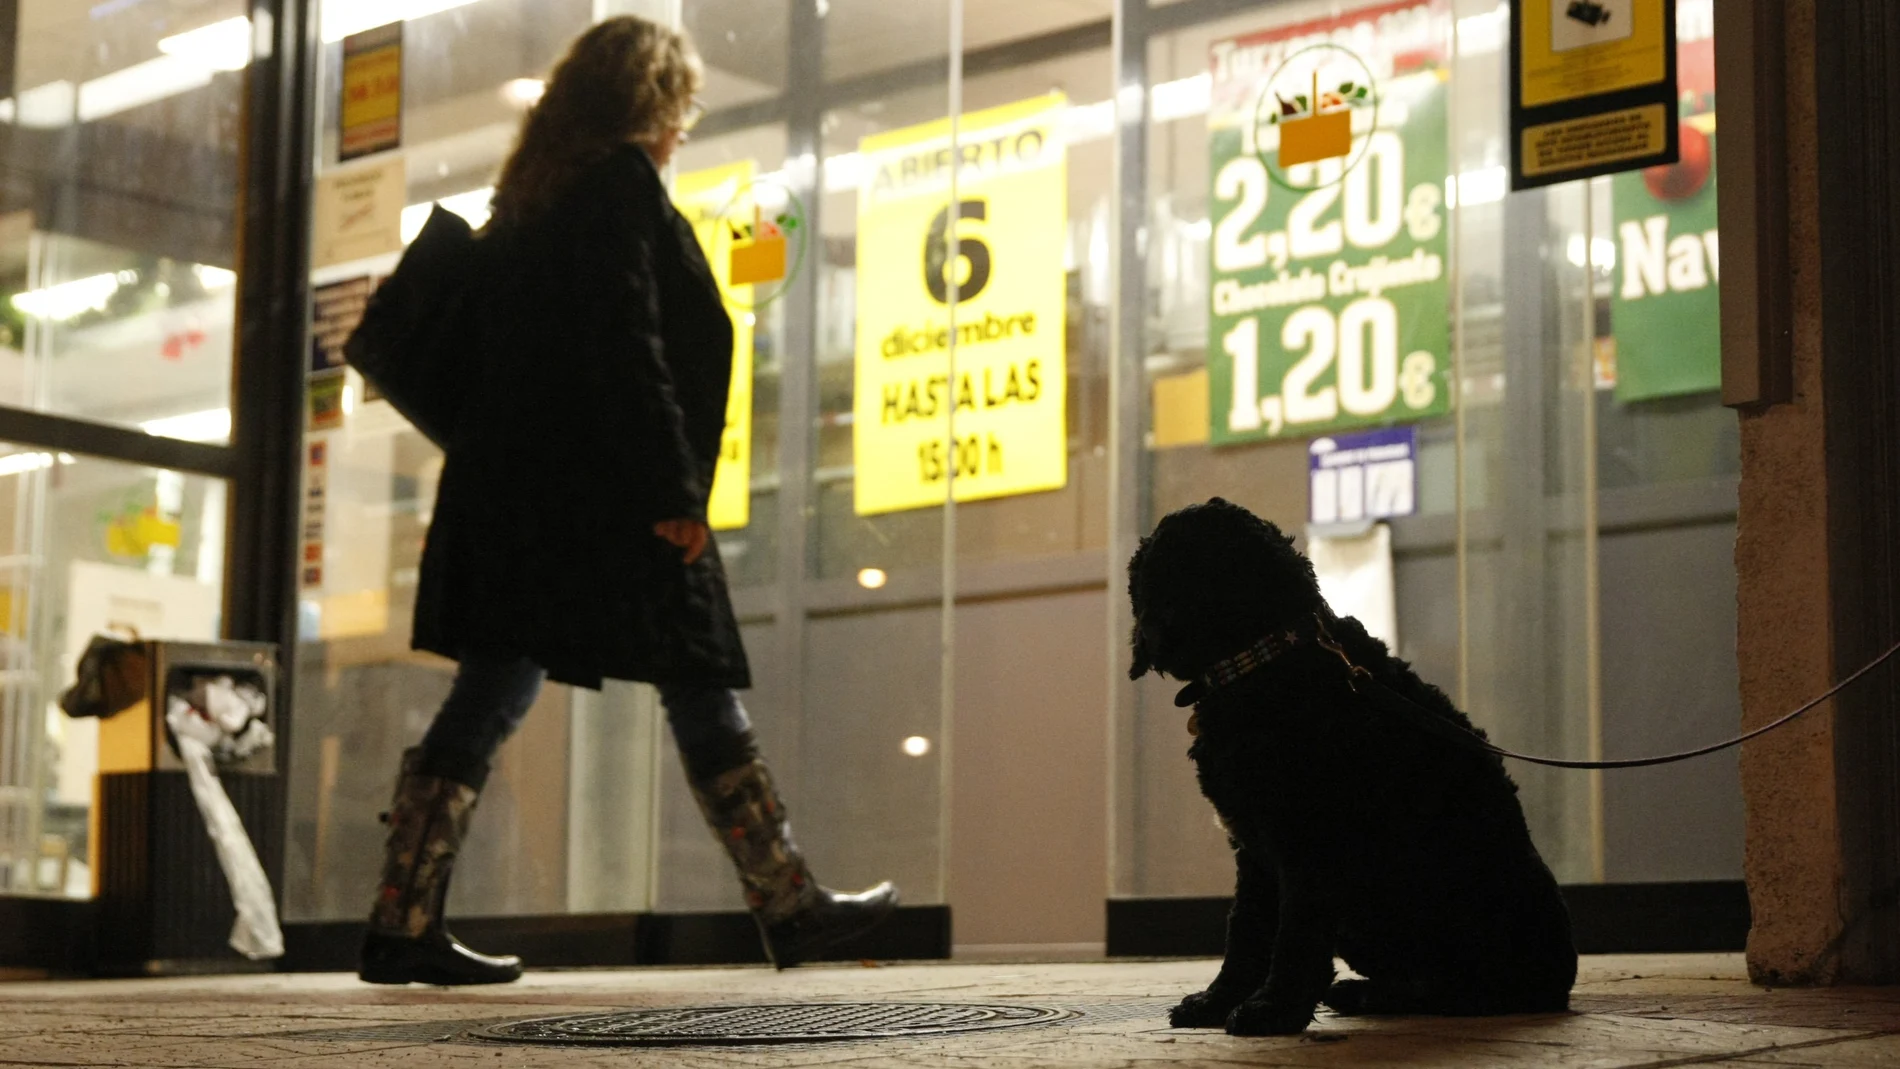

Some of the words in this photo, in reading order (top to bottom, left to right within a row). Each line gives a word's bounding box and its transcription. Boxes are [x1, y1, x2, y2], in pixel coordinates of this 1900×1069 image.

[873, 129, 1043, 191] ABIERTO
[924, 200, 991, 304] 6
[881, 313, 1036, 359] diciembre
[881, 371, 976, 425] HASTA
[985, 359, 1040, 407] LAS
